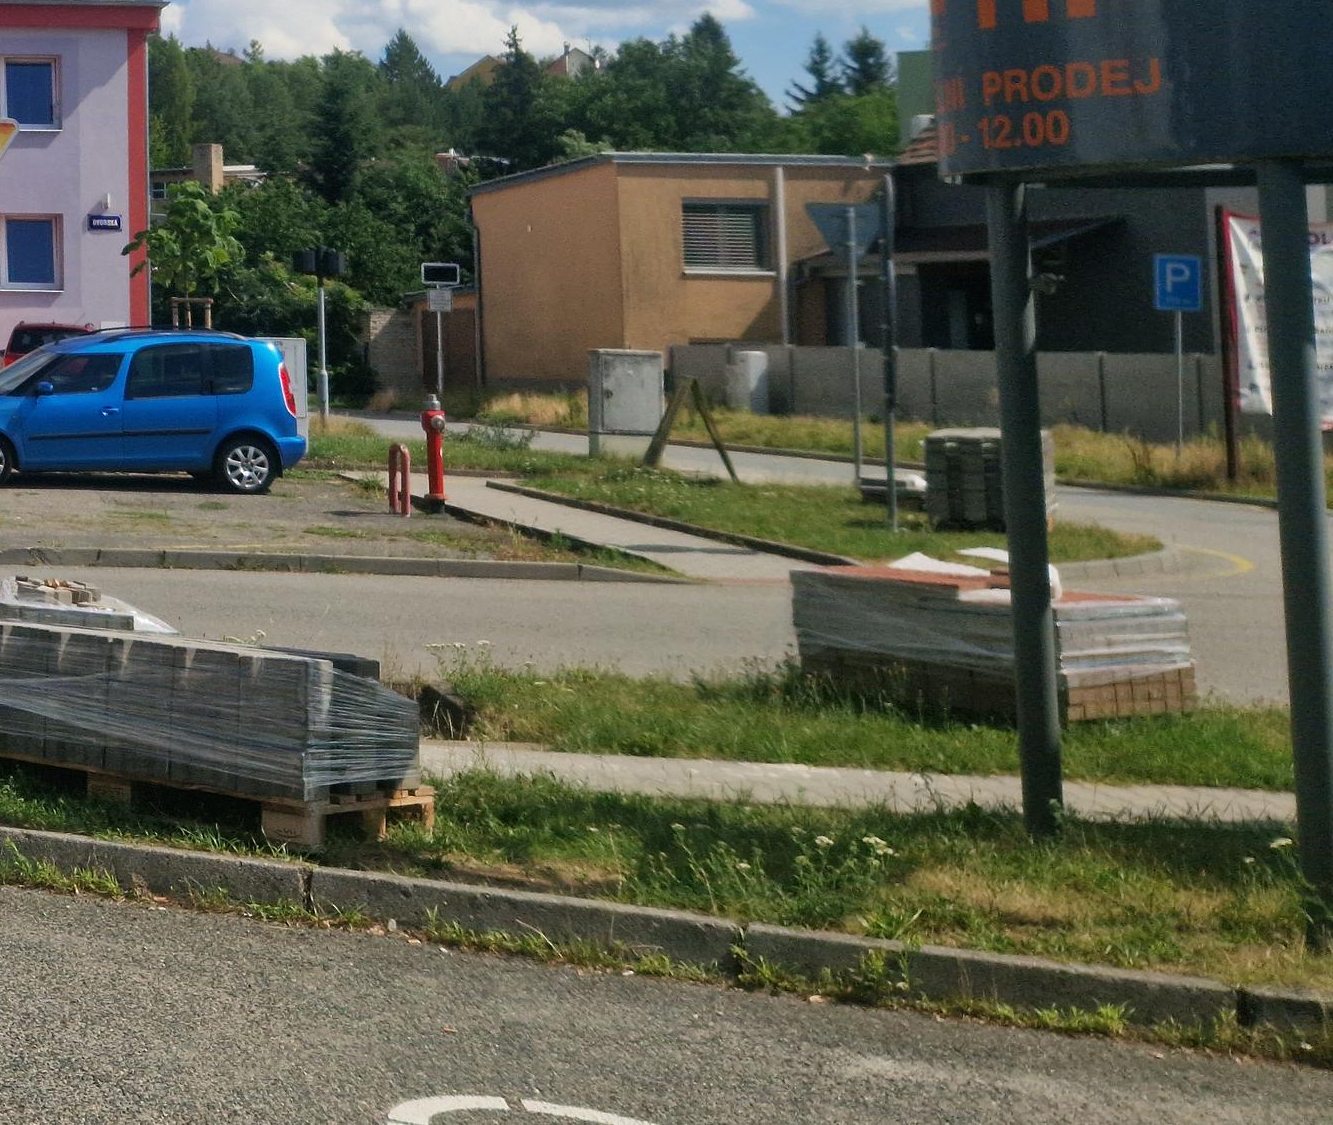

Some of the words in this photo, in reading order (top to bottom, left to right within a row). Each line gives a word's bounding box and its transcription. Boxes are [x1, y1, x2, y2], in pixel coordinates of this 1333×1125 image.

[982, 59, 1163, 107] PRODEJ
[978, 111, 1071, 150] 12.00
[1165, 263, 1190, 293] P
